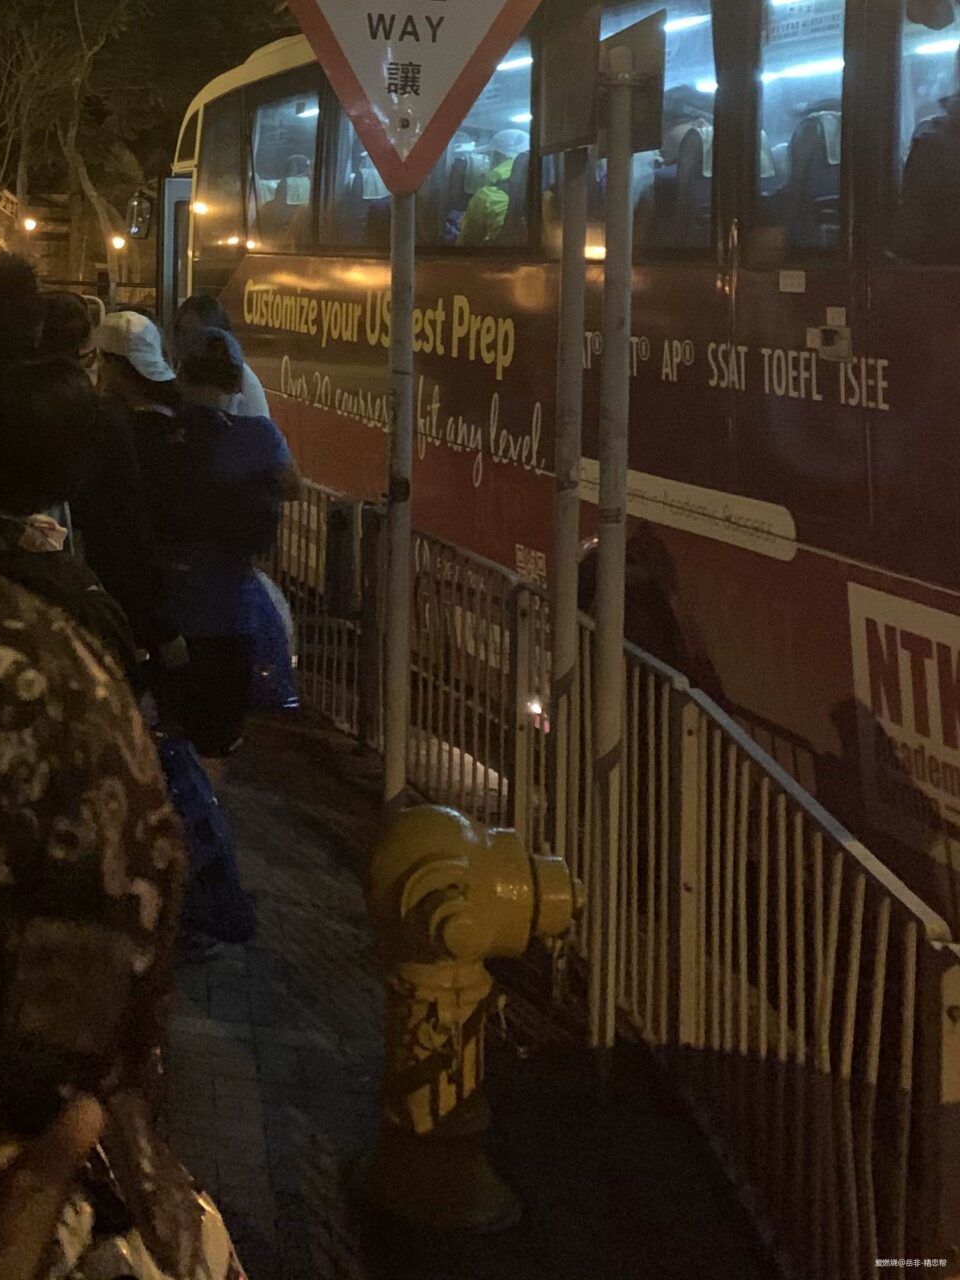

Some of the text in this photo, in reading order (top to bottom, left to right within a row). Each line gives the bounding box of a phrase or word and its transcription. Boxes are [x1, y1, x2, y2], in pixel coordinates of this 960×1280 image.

[367, 12, 445, 43] WAY
[386, 62, 422, 96] 讓
[243, 278, 319, 335] Customize
[321, 300, 361, 348] your
[413, 297, 445, 355] est
[451, 294, 515, 380] Prep
[707, 342, 748, 392] SSAT
[761, 347, 823, 401] TOEFL
[839, 356, 889, 411] ISEE
[312, 371, 330, 410] 20
[416, 375, 441, 461] fit
[445, 415, 483, 488] any
